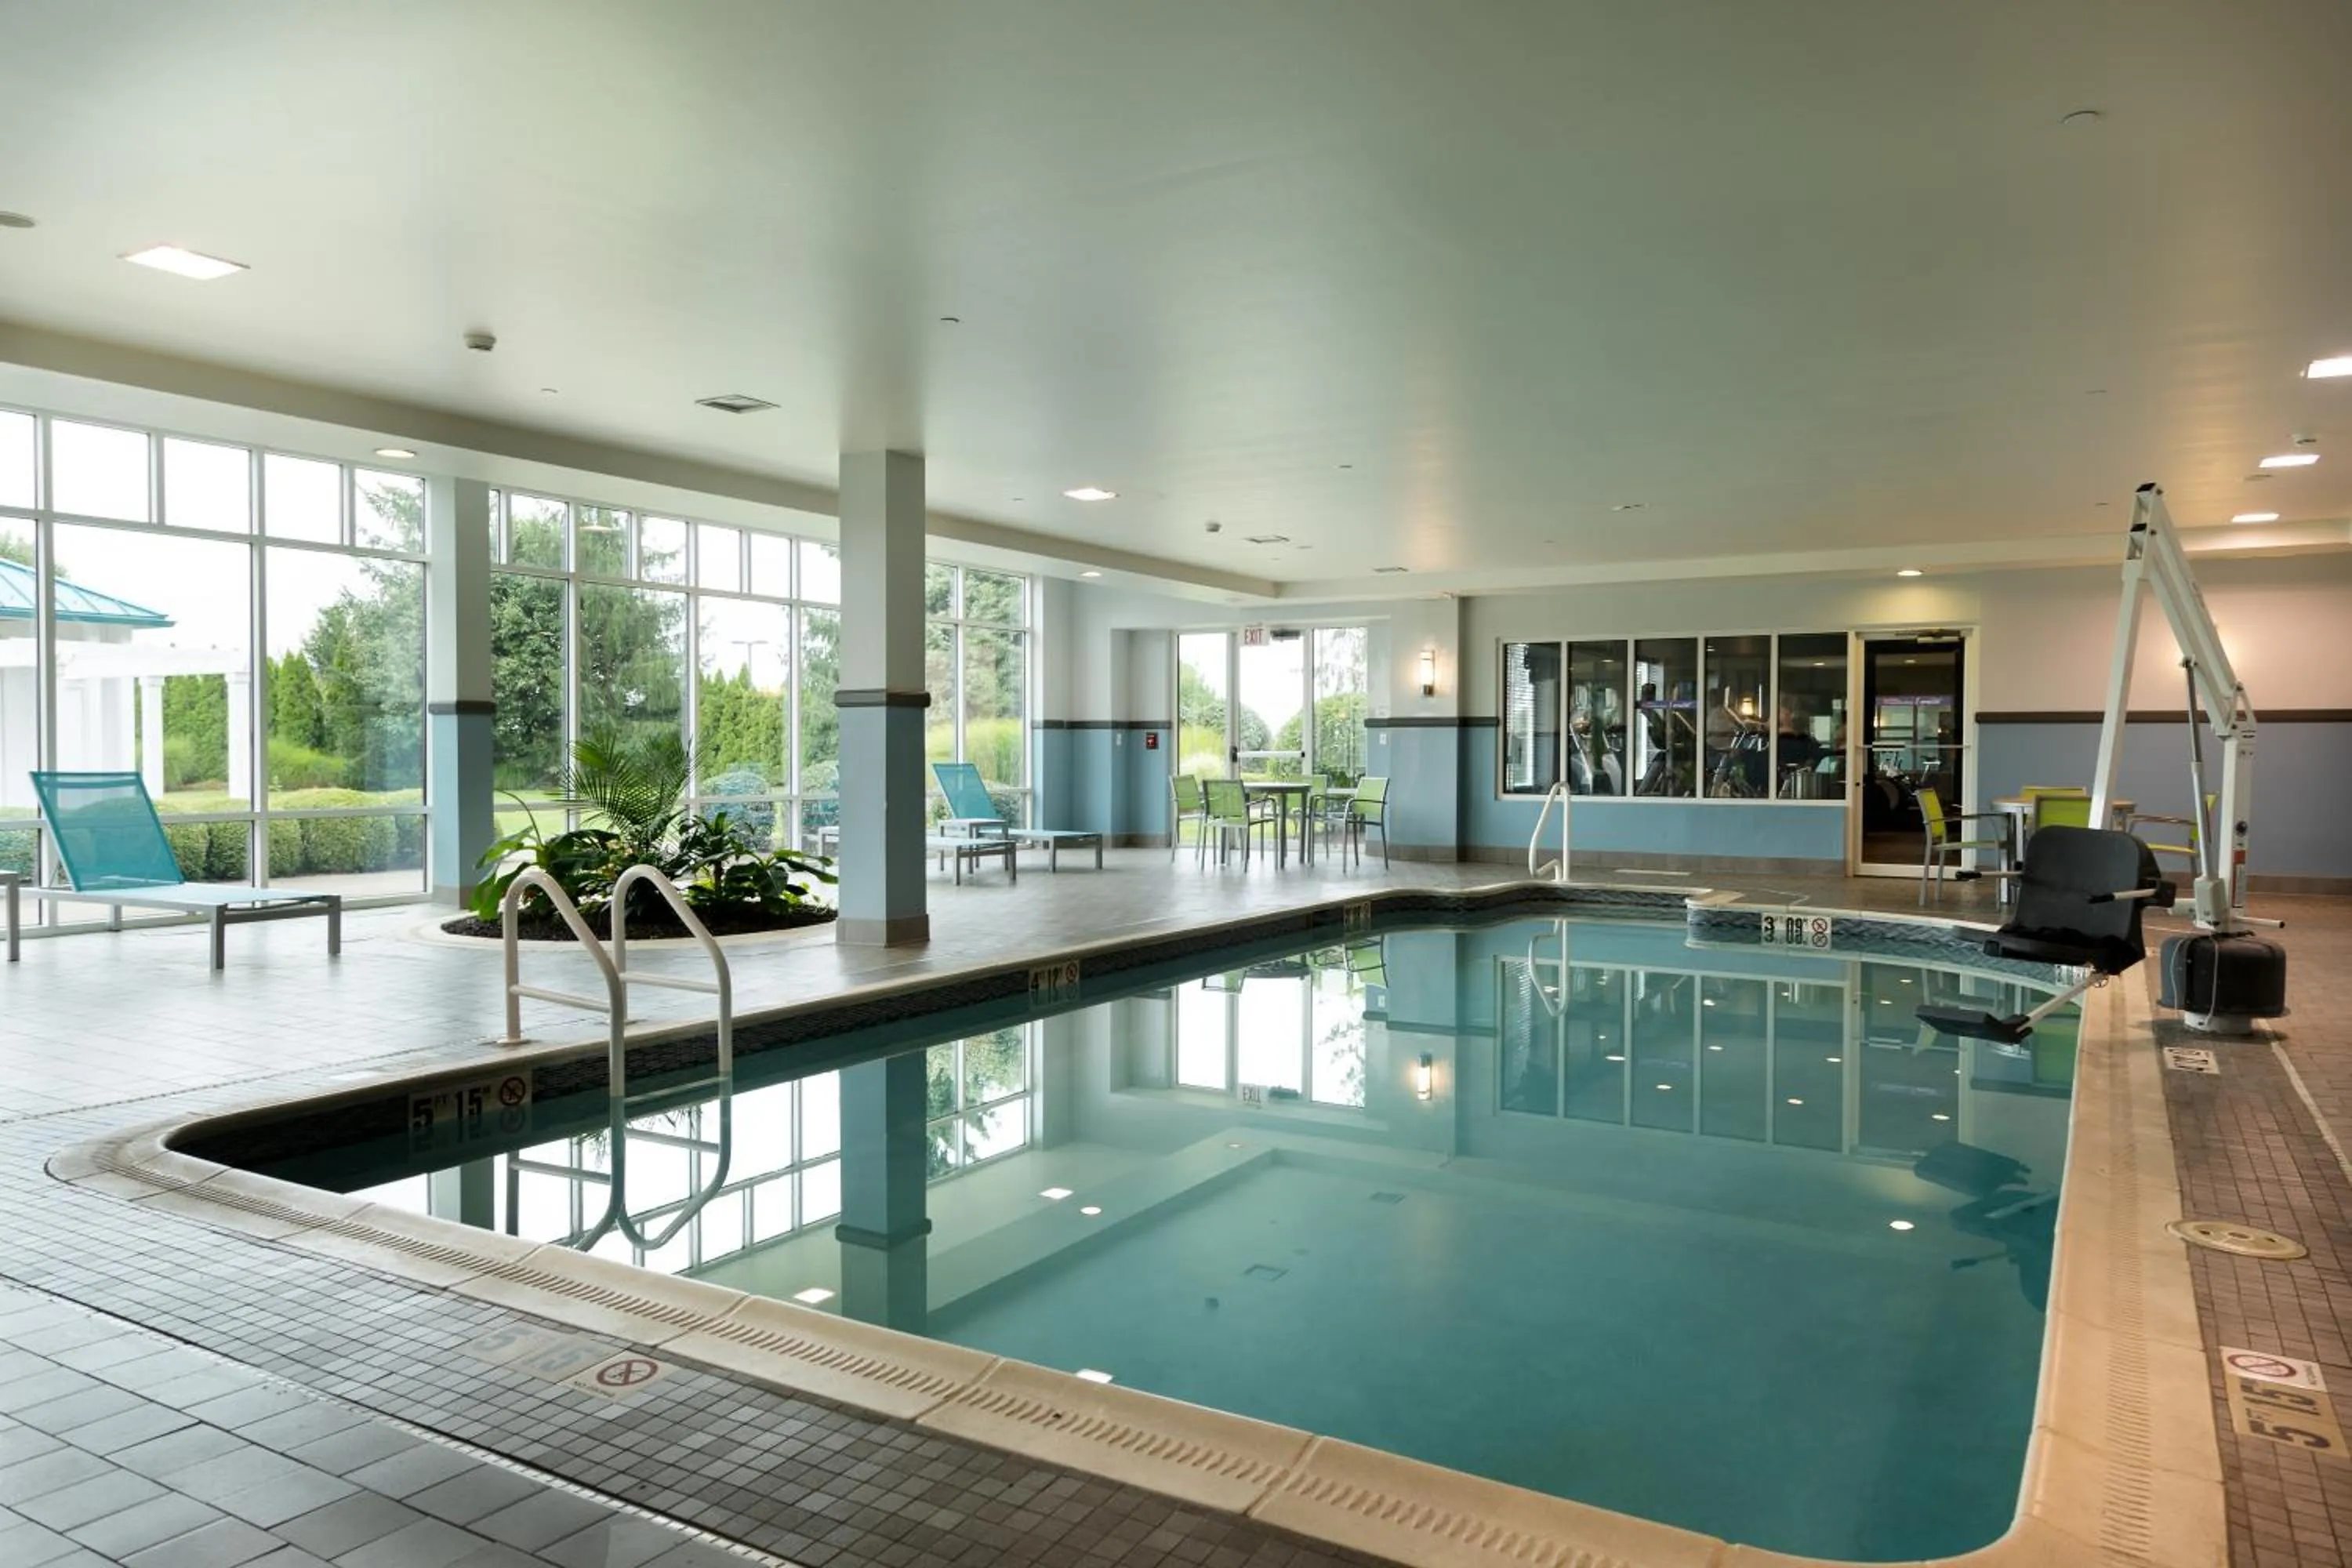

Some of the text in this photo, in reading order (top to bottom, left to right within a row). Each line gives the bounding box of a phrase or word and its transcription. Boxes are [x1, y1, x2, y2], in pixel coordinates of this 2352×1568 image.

[1244, 628, 1265, 645] EXIT
[1764, 916, 1775, 931] 3
[412, 1098, 434, 1127] 5
[2249, 1419, 2332, 1448] 5
